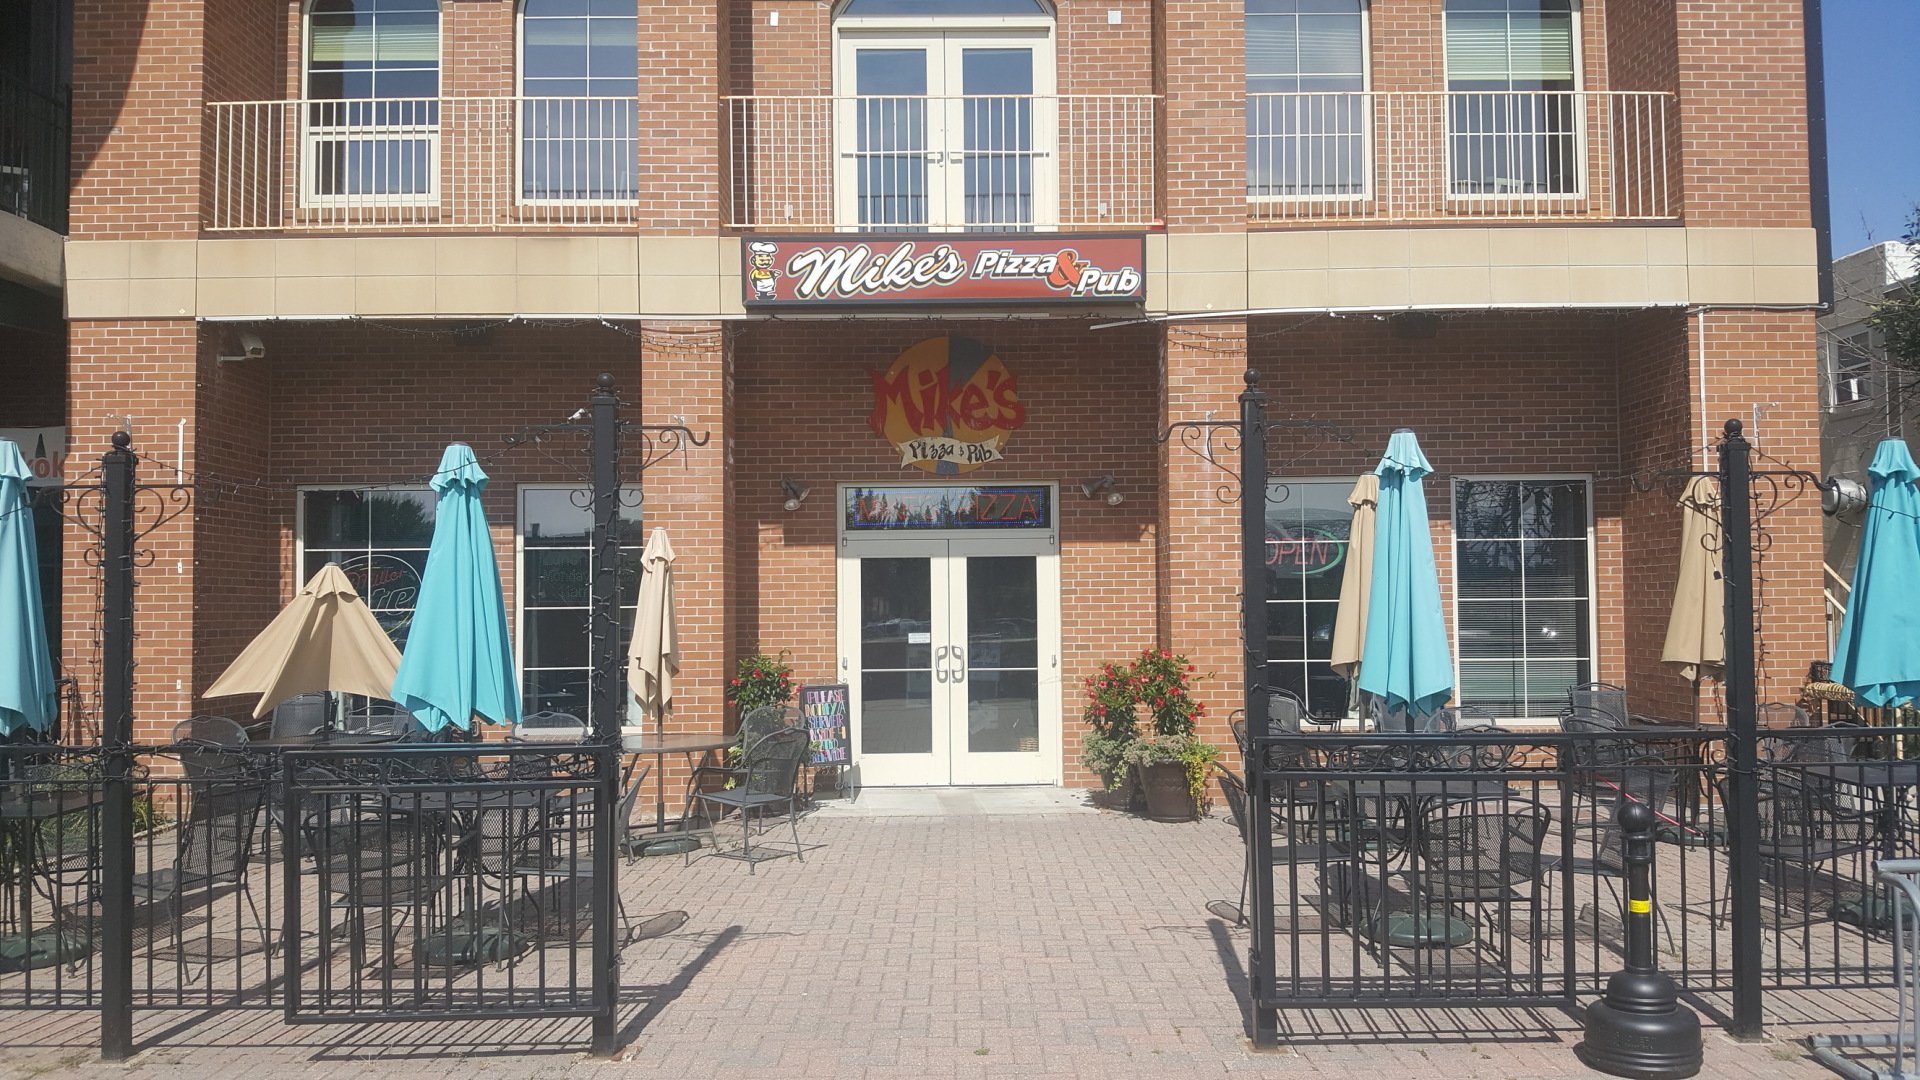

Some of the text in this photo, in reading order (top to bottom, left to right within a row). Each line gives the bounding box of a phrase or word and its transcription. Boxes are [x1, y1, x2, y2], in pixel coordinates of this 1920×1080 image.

[790, 242, 1140, 297] Mike's Pizza & Pub
[866, 365, 1025, 437] Mike's
[966, 443, 993, 464] Pub
[1264, 537, 1329, 565] OPEN
[806, 689, 846, 704] PLEASE
[807, 714, 845, 730] SERVER
